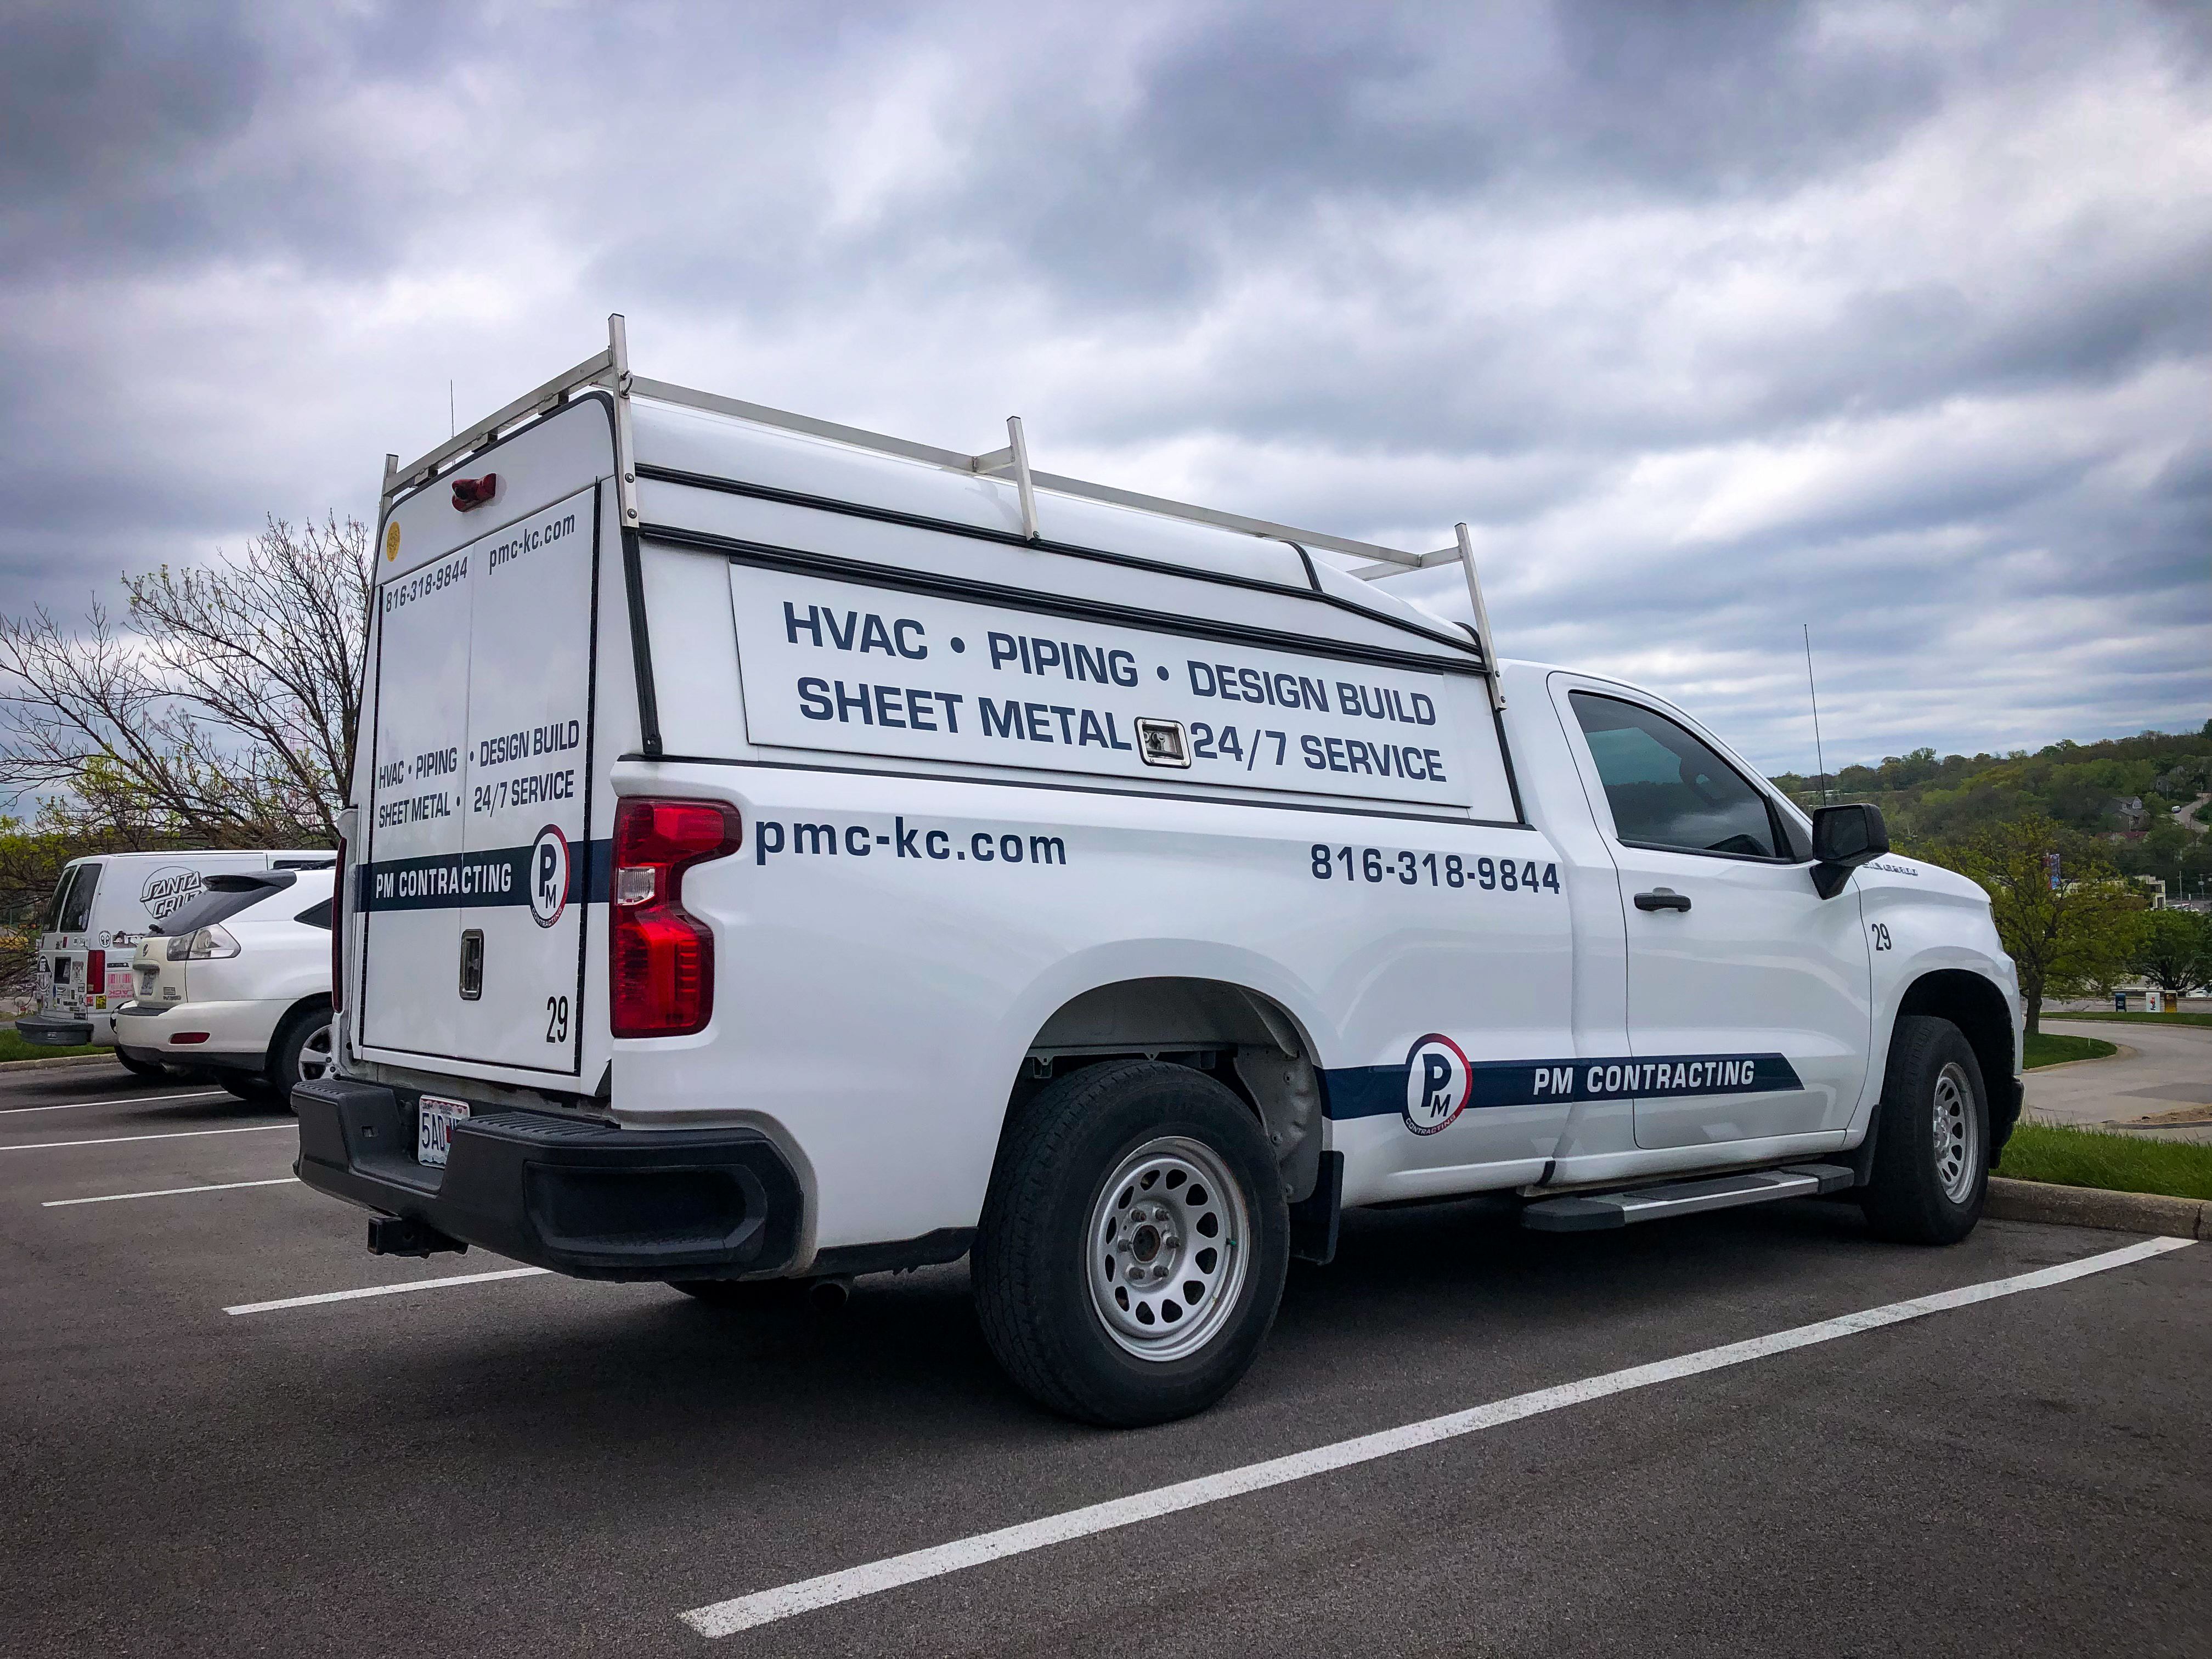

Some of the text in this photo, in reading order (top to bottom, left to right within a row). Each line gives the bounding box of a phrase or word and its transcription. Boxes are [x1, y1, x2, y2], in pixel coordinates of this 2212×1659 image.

[489, 514, 575, 575] pmc-kc.com
[386, 556, 468, 613] 816-318-9844
[783, 601, 1436, 726] HVAC PIPING DESIGN BUILD
[379, 720, 579, 789] HVAC PIPING DESIGN BUILD
[797, 676, 1447, 783] SHEET METAL 24/7 SERVICE
[379, 769, 574, 828] SHEET METAL 24/7 SERVICE
[756, 816, 1066, 866] pmc-kc.com
[140, 871, 201, 902] SANTA
[376, 863, 511, 898] PM CONTRACTING
[1311, 844, 1560, 895] 816-318-9844
[1872, 923, 1892, 951] 29
[546, 996, 568, 1043] 29
[1533, 1060, 1754, 1095] PM CONTRACTING
[1406, 1114, 1456, 1135] CONTRACTING
